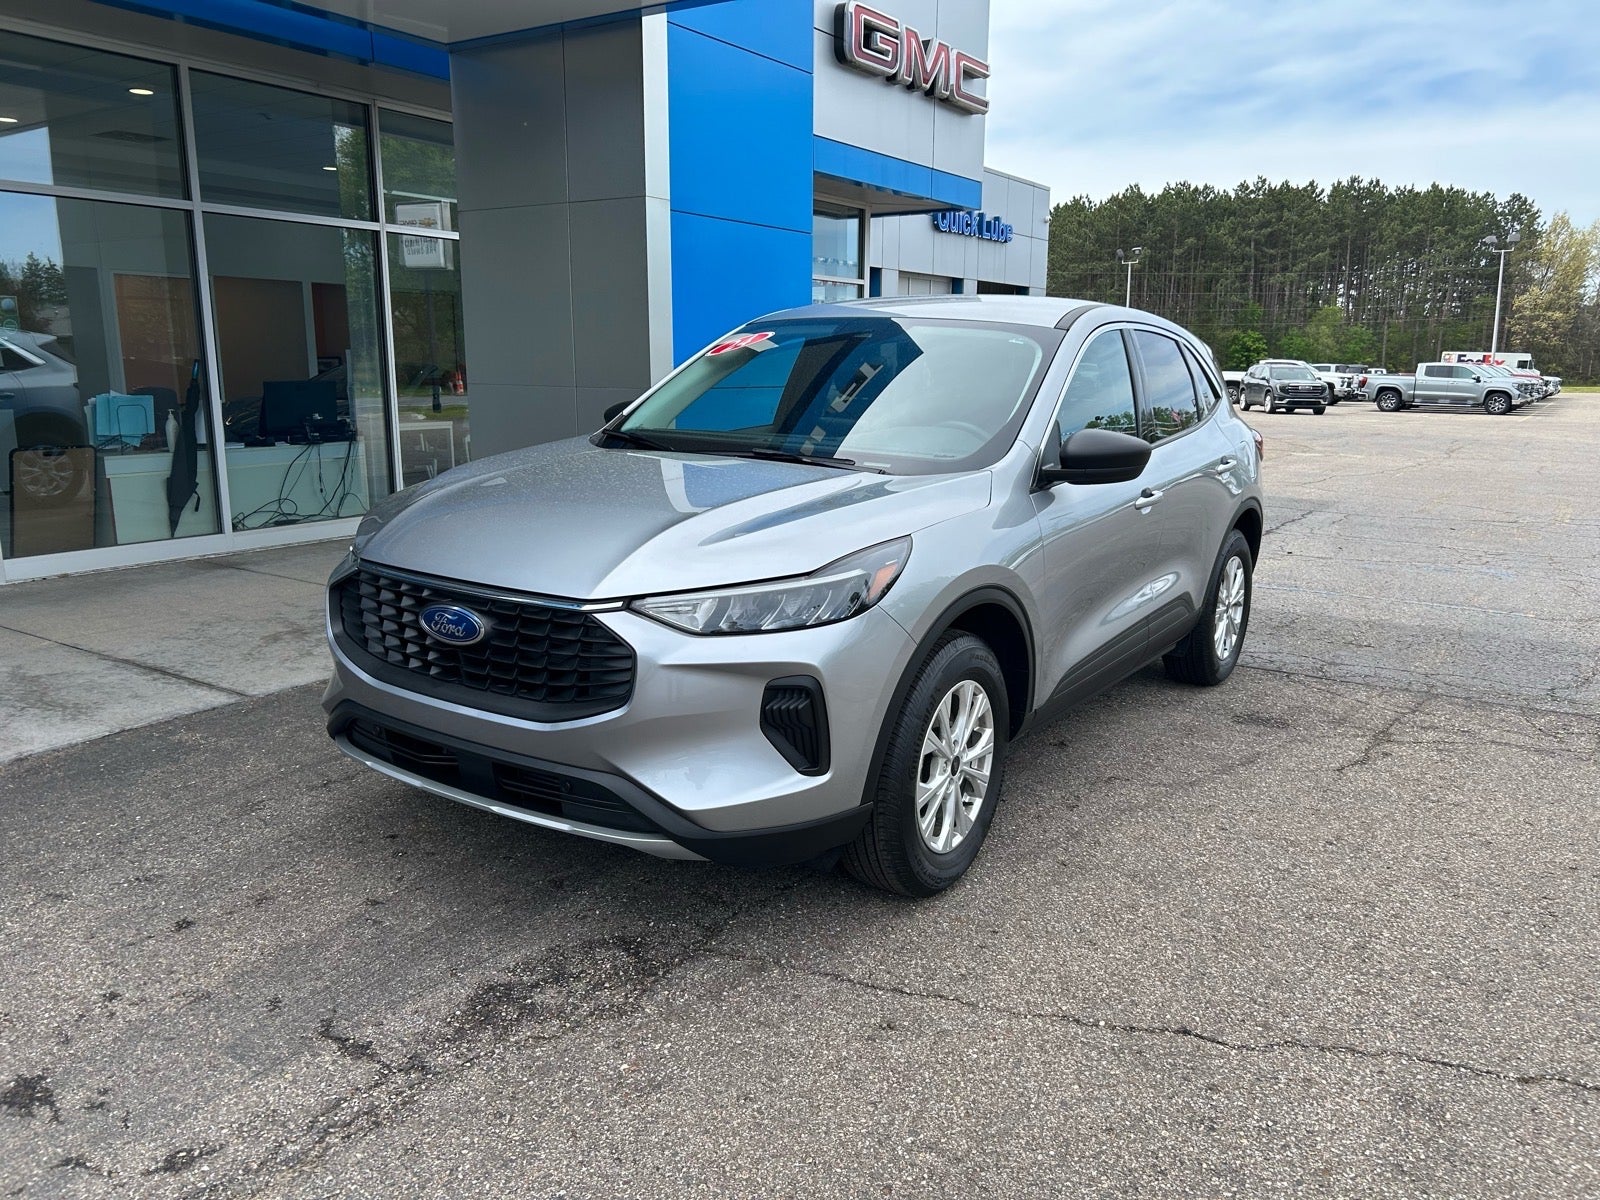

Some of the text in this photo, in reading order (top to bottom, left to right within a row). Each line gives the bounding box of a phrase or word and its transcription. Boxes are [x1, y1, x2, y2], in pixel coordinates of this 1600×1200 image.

[846, 2, 990, 113] GMC
[937, 210, 1014, 242] Quick Lube
[431, 612, 466, 637] Ford
